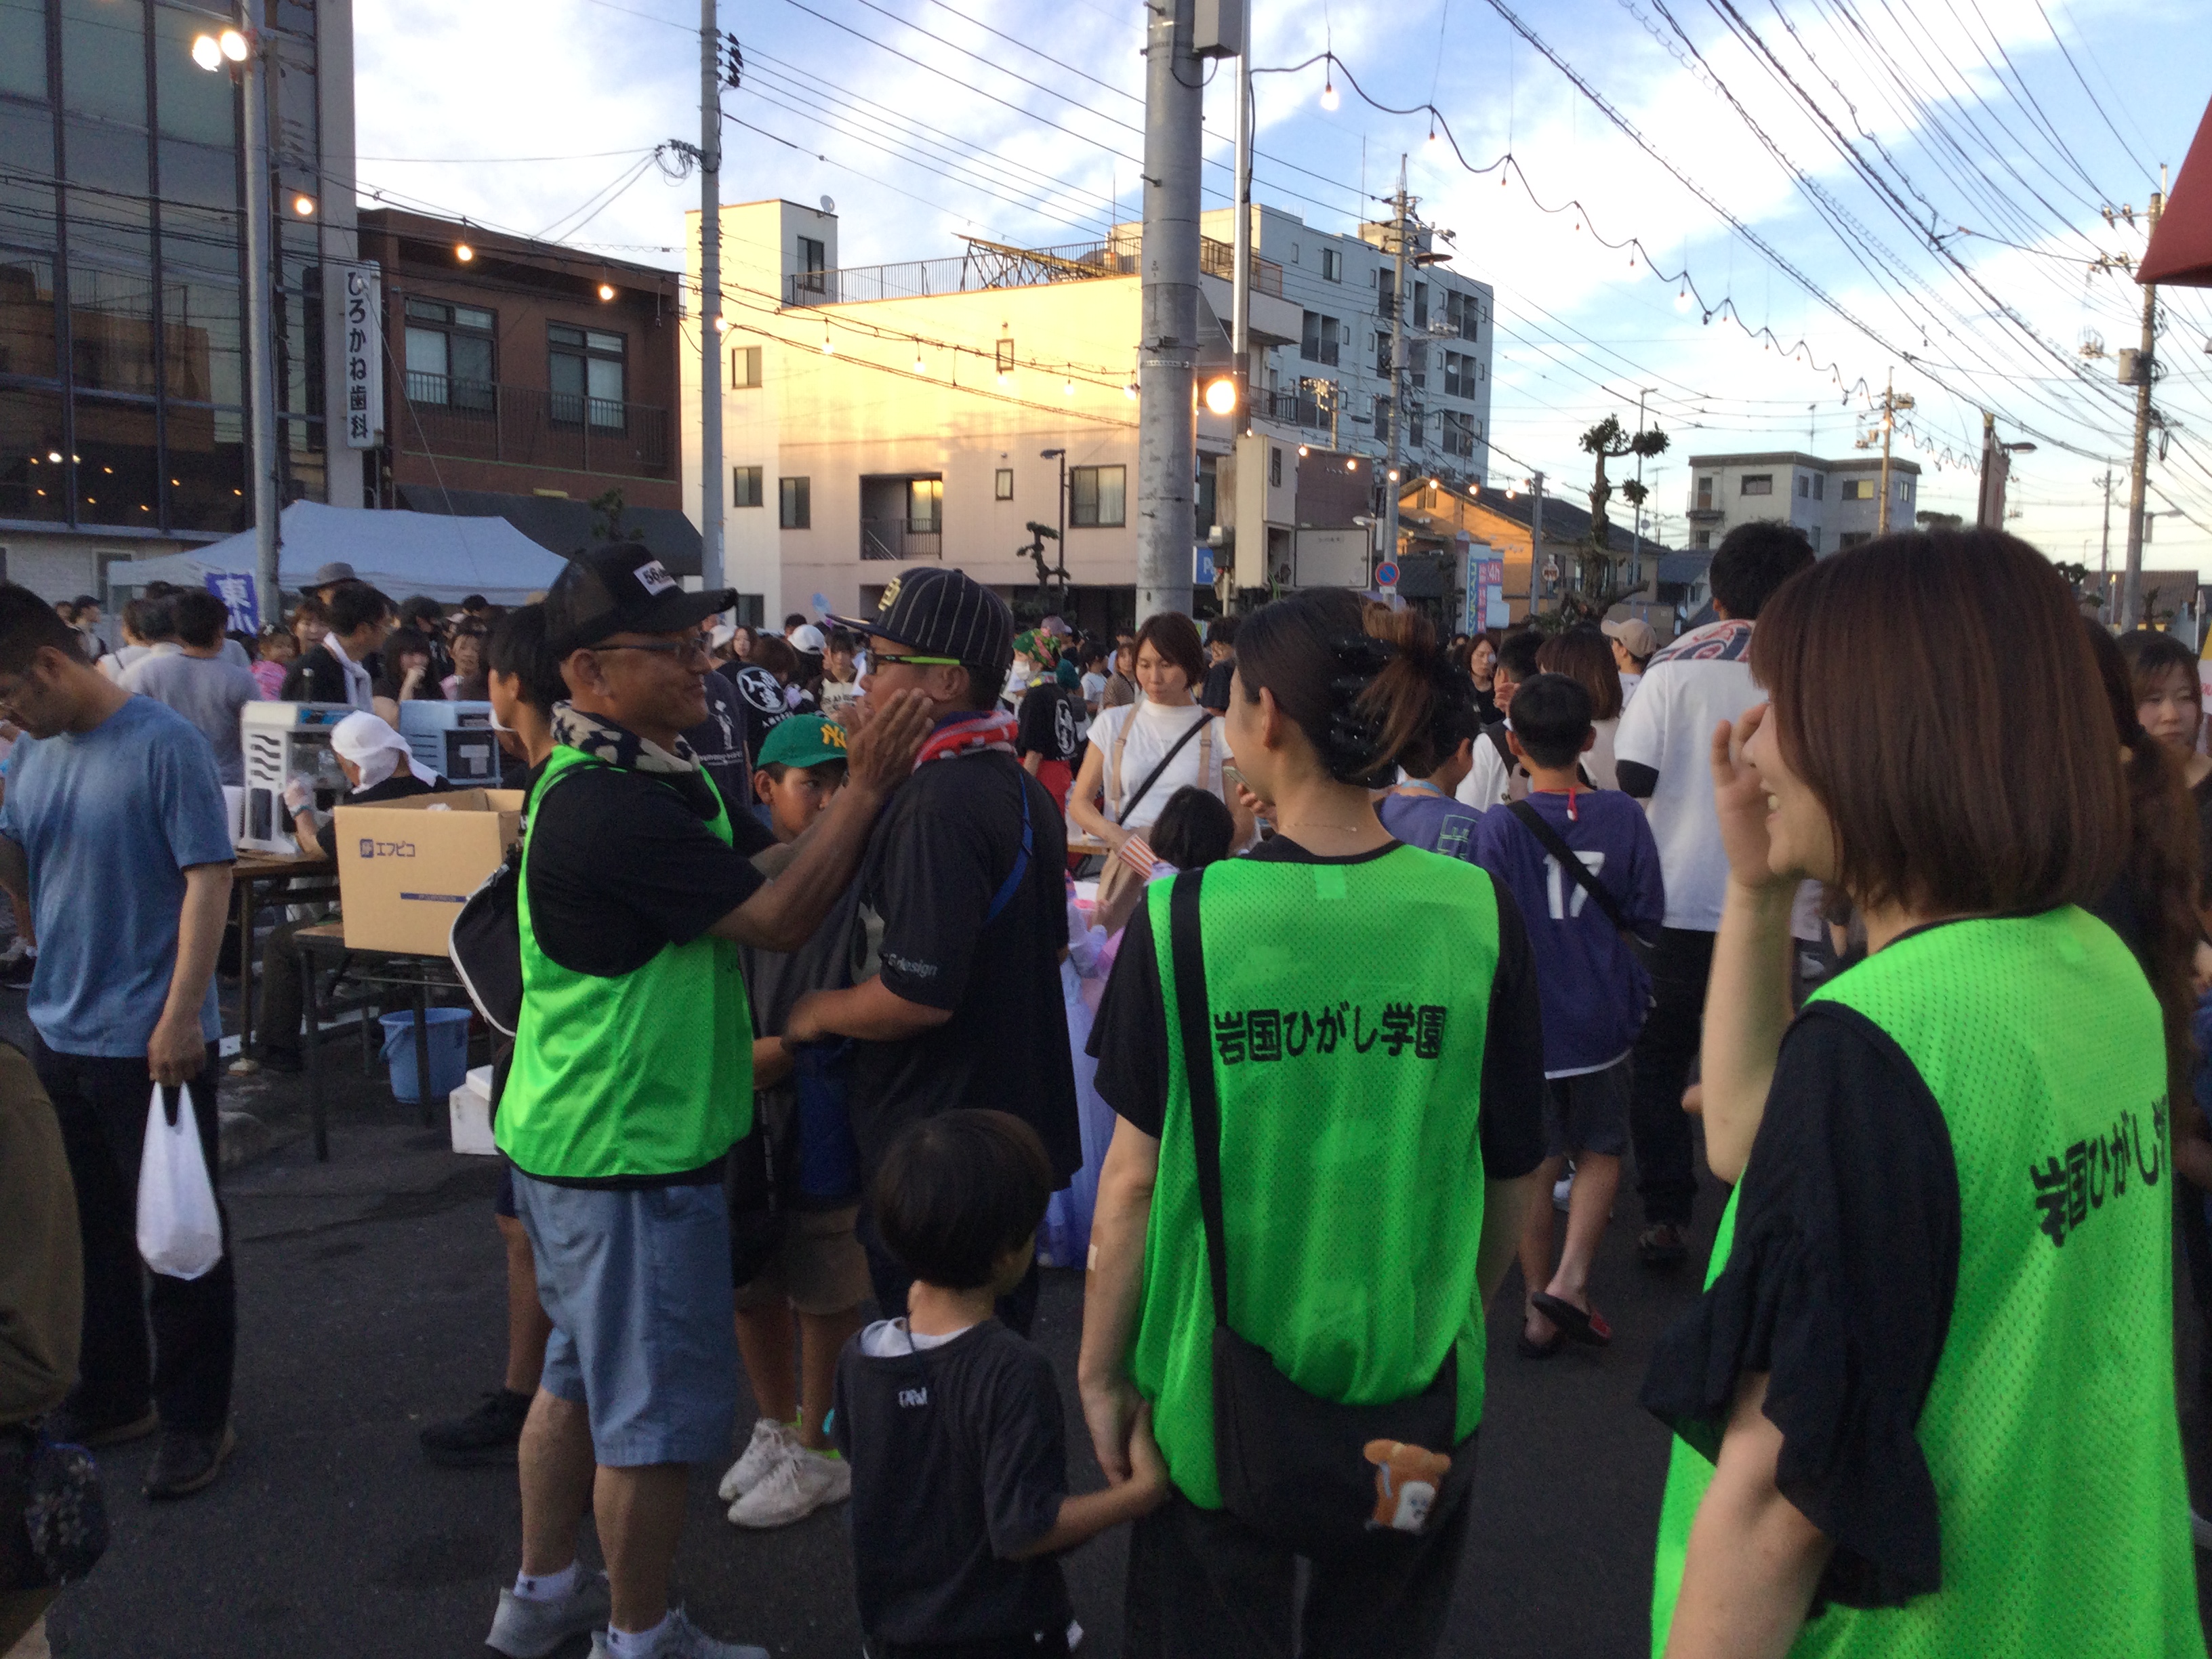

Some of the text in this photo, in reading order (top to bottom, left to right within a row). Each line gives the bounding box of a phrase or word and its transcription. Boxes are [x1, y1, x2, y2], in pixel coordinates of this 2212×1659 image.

[348, 272, 368, 439] ひろかね歯科
[376, 840, 415, 857] エフピコ
[1542, 850, 1605, 920] 17
[1214, 1000, 1446, 1065] 岩国ひがし学園
